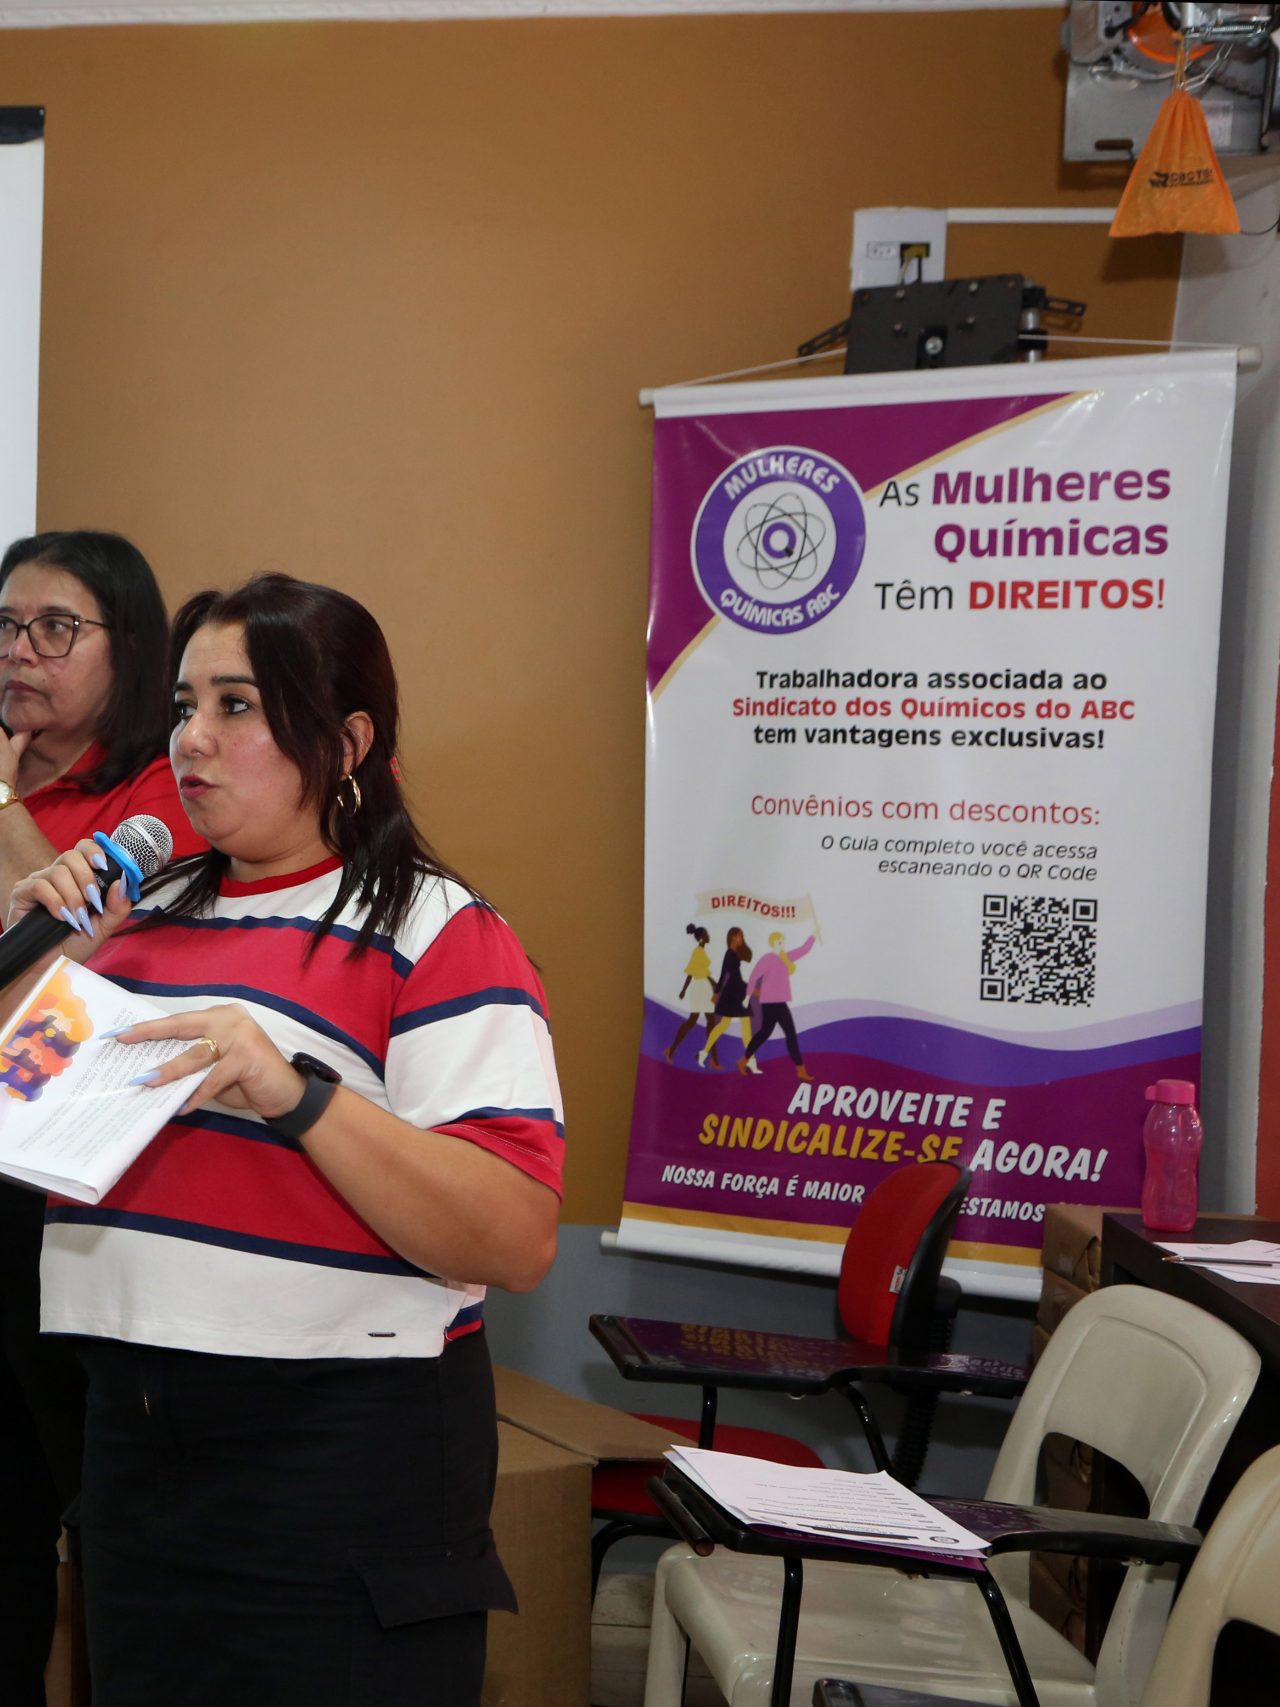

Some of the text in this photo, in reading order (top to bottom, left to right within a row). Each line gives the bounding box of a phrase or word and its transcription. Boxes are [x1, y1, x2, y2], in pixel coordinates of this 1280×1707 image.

[724, 454, 841, 500] MULHERES
[879, 467, 1171, 508] As Mulheres
[934, 518, 1169, 564] Químicas
[720, 583, 841, 627] QUÍMICAS ABC
[874, 578, 1164, 611] Têm DIREITOS!
[756, 668, 1108, 690] Trabalhadora associada ao
[732, 698, 1135, 720] Sindicato dos Químicos do ABC
[754, 727, 1105, 749] tem vantagens exclusivas!
[751, 794, 1101, 826] Convênios com descontos:
[821, 836, 1098, 860] O Guia completo você acessa
[878, 859, 1098, 882] escaneando o QR Code
[711, 894, 796, 920] DIREITOS!!!
[787, 1082, 1006, 1131] APROVEITE E
[698, 1113, 1109, 1183] SINDICALIZE-SE AGORA!
[661, 1164, 716, 1189] NOSSA
[720, 1172, 780, 1198] FORÇA
[785, 1174, 800, 1197] É
[802, 1180, 866, 1204] MAIOR
